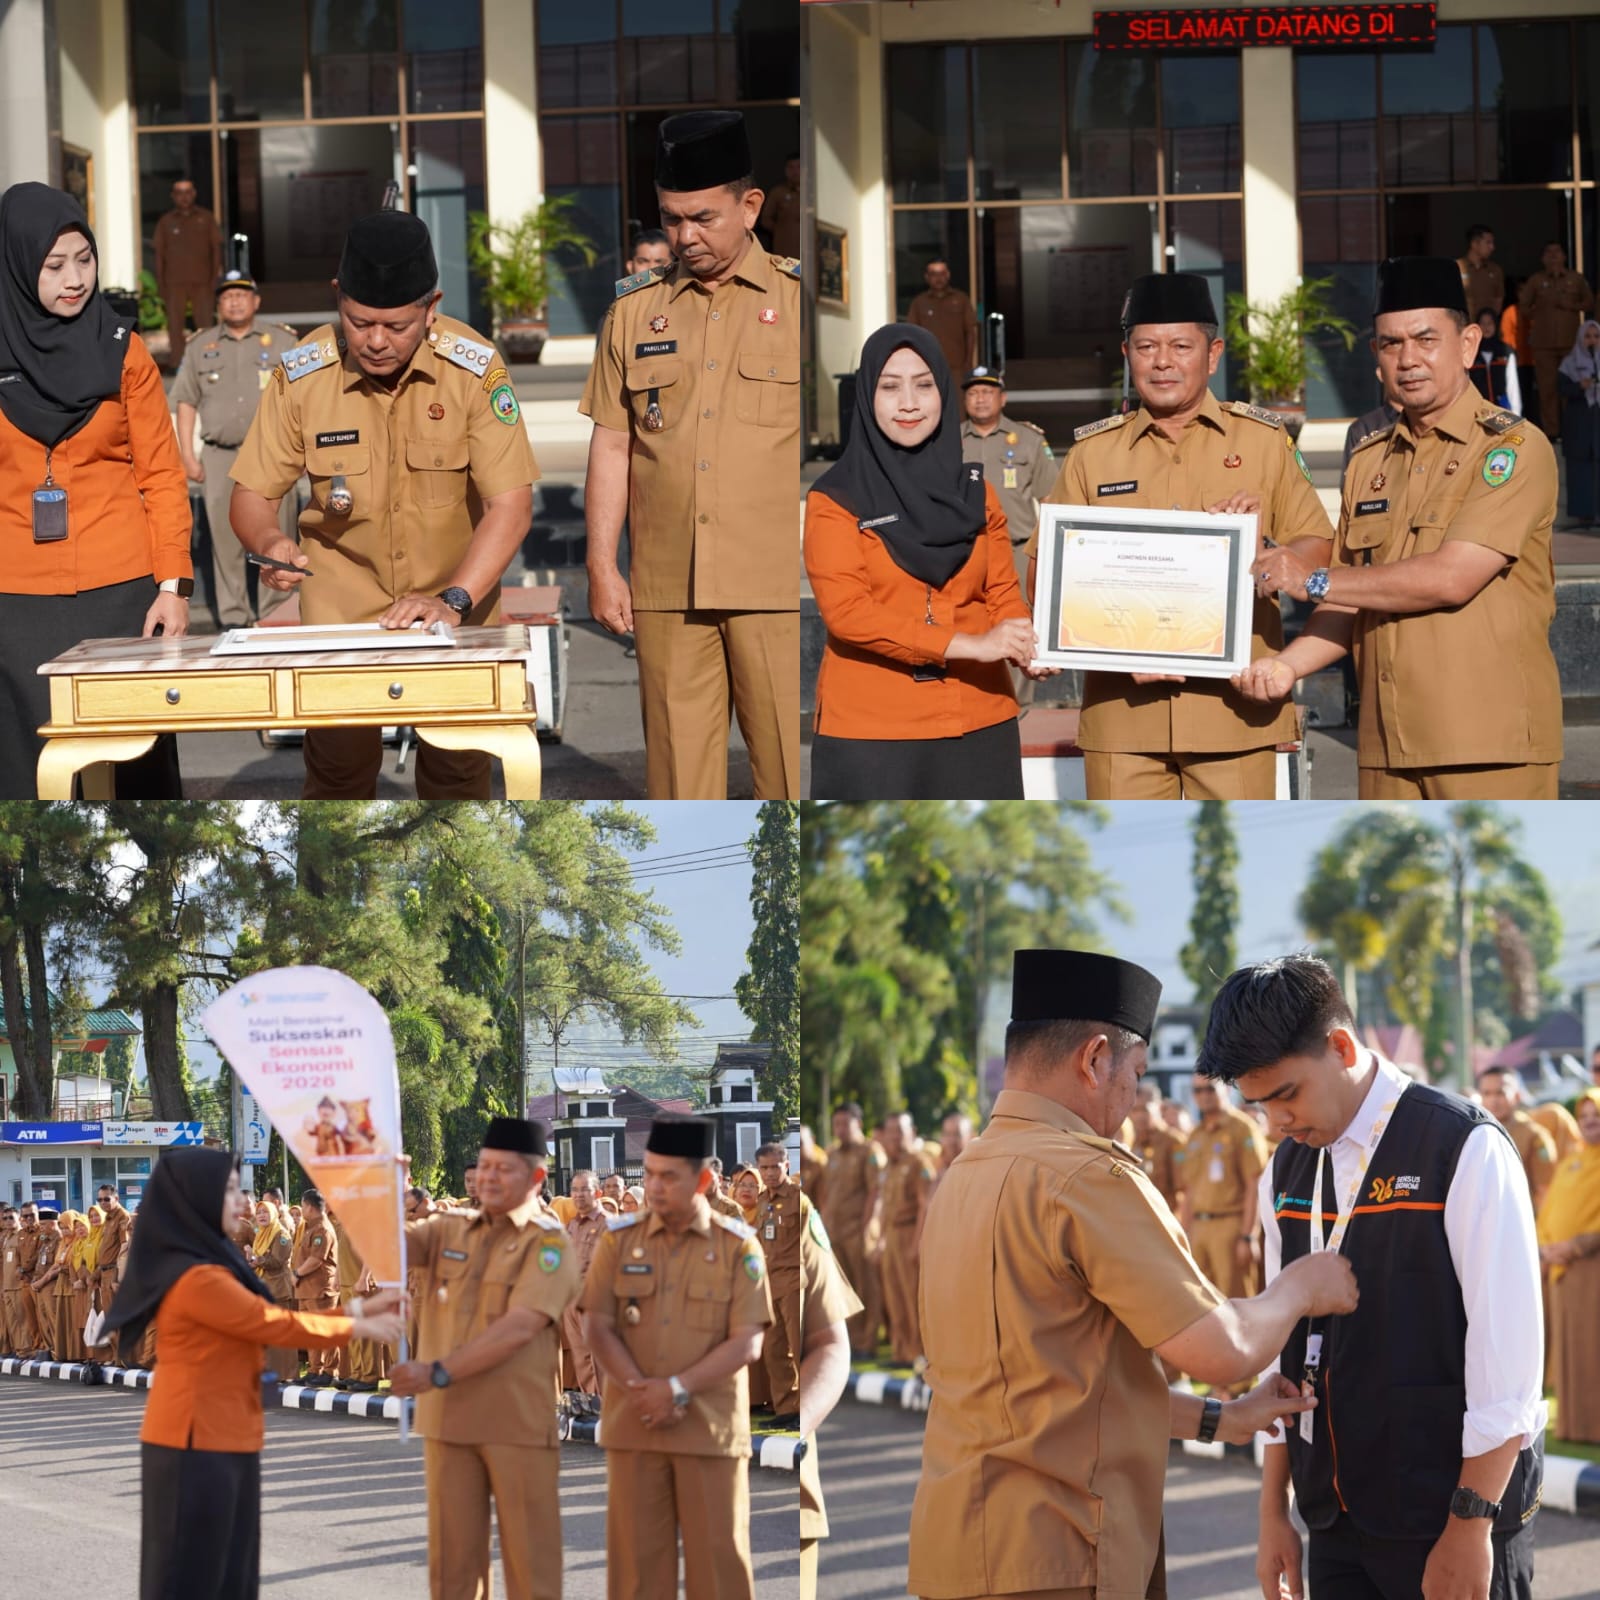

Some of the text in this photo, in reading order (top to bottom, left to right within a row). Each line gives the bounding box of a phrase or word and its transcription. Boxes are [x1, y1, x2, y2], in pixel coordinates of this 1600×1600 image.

[1128, 12, 1394, 40] SELAMAT DATANG DI
[643, 344, 669, 352] PARULIAN
[249, 1027, 362, 1042] Sukseskan
[269, 1043, 344, 1058] Sensus
[261, 1058, 354, 1074] Ekonomi
[282, 1076, 335, 1089] 2026
[17, 1130, 47, 1140] ATM
